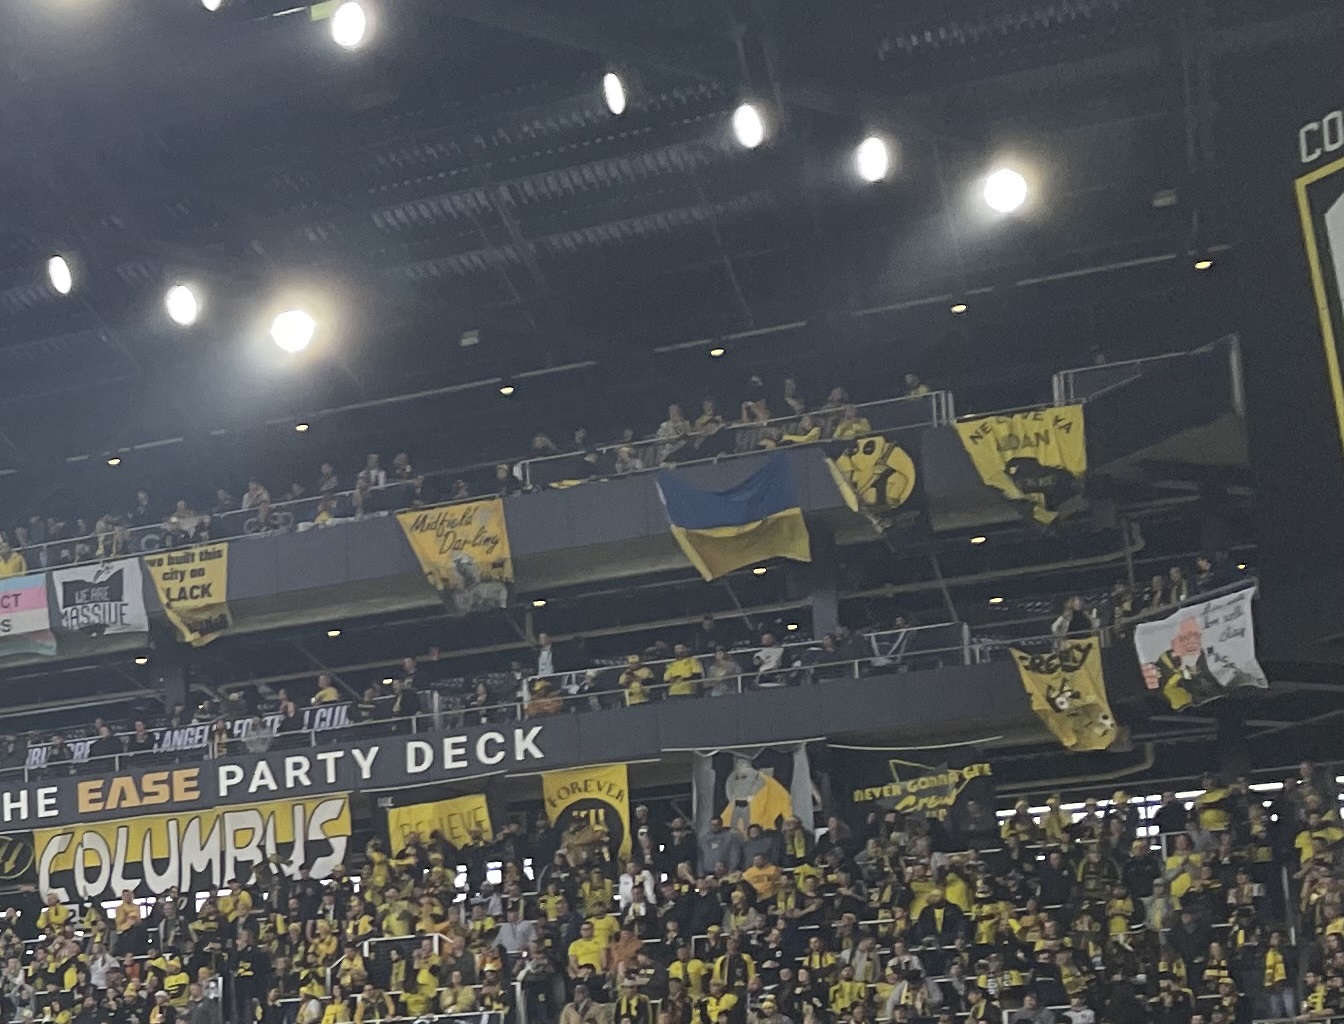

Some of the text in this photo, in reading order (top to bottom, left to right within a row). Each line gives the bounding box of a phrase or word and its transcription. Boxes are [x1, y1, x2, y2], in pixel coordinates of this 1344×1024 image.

[439, 526, 500, 555] Darling
[78, 767, 201, 814] EASE
[218, 746, 380, 798] PARTY
[406, 725, 546, 776] DECK
[853, 784, 902, 803] NEVER
[38, 797, 351, 904] COLUMBUS
